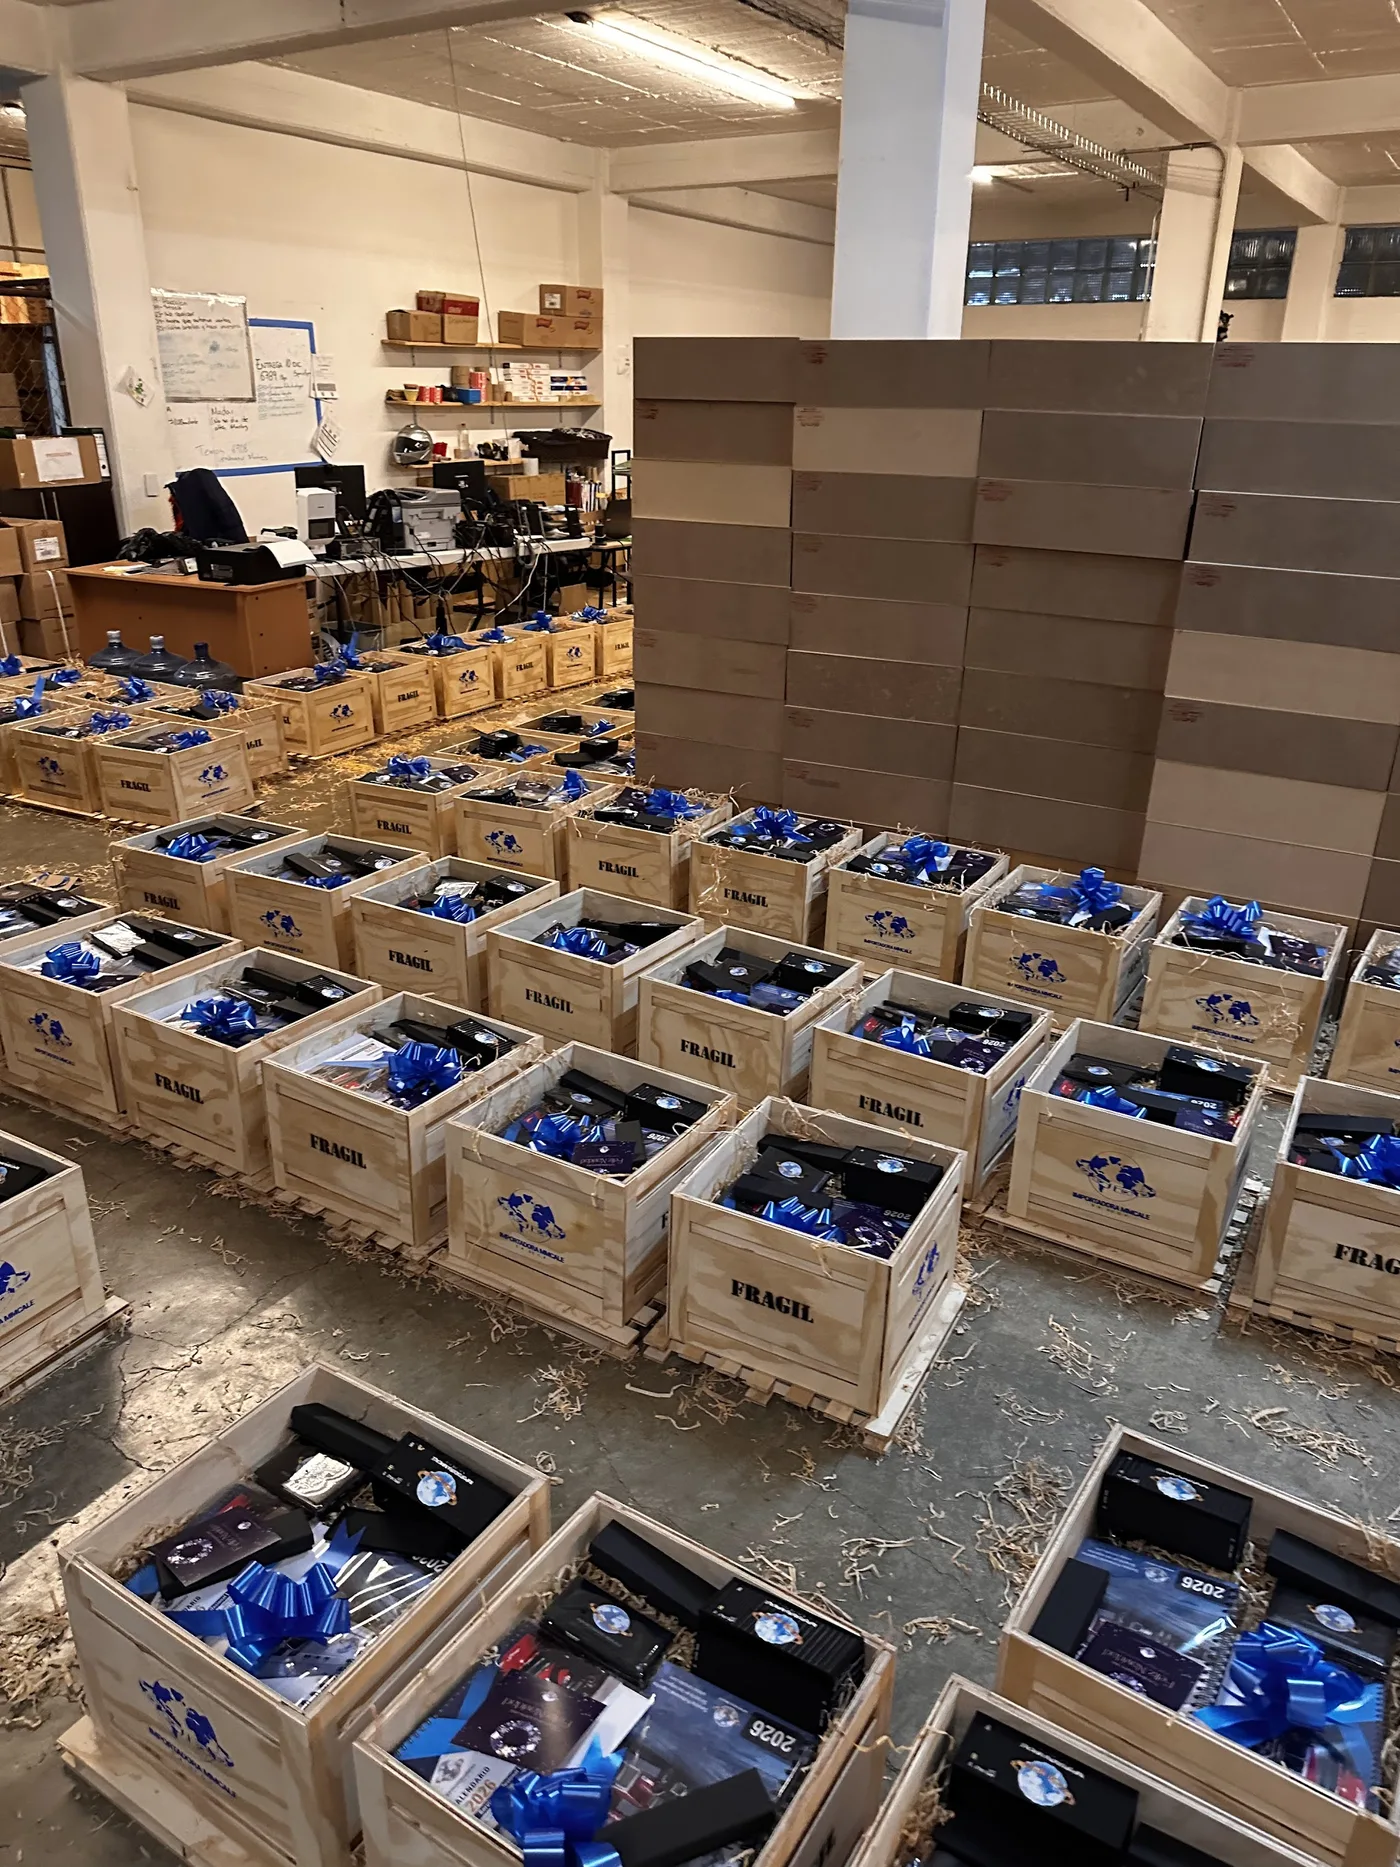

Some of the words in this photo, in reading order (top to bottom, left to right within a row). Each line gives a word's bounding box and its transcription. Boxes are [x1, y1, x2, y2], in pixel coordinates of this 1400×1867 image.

[516, 662, 534, 671] FRAGIL
[397, 690, 419, 702] FRAGIL
[120, 779, 152, 792] FRAGIL
[377, 820, 412, 834] FRAGIL
[599, 860, 639, 878] FRAGIL
[144, 892, 180, 910] FRAGIL
[724, 888, 768, 908] FRAGIL
[389, 950, 433, 972] FRAGIL
[526, 988, 573, 1014] FRAGIL
[681, 1039, 736, 1068] FRAGIL
[155, 1072, 204, 1104] FRAGIL
[859, 1095, 924, 1128] FRAGIL
[310, 1133, 367, 1169] FRAGIL
[883, 1209, 912, 1220] 2026
[1333, 1243, 1400, 1275] FRAG
[731, 1279, 814, 1324] FRAGIL
[1181, 1576, 1226, 1599] 2026
[750, 1720, 796, 1752] 2026
[455, 1766, 490, 1805] ALENDARIO
[465, 1780, 497, 1812] 2026
